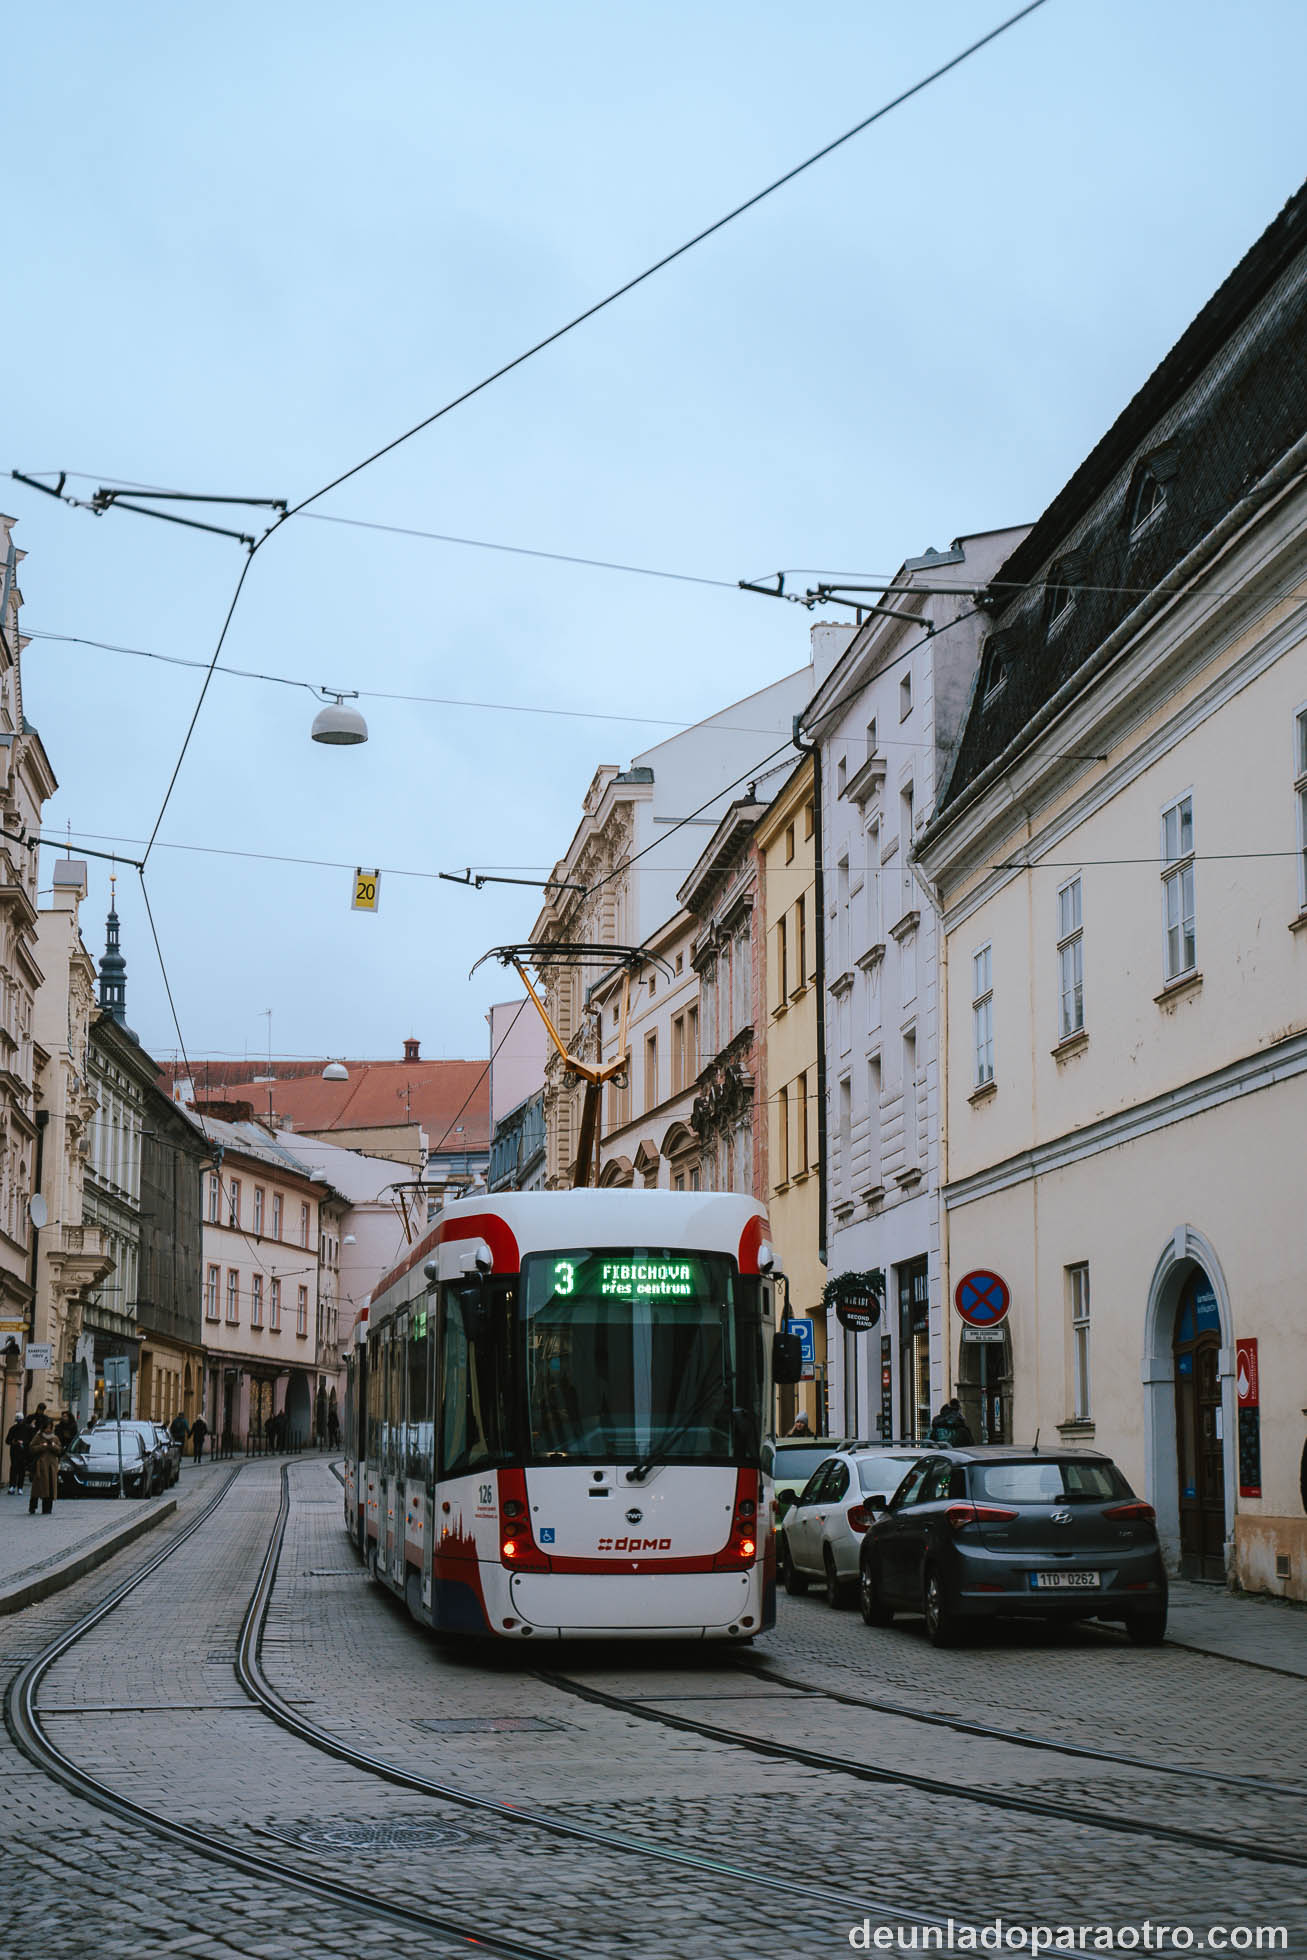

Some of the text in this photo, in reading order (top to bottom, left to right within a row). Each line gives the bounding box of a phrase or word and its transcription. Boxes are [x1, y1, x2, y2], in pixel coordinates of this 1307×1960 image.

[356, 882, 376, 900] 20
[554, 1262, 574, 1295] 3
[636, 1281, 691, 1294] centrum
[847, 1313, 870, 1322] SECOND
[479, 1484, 493, 1504] 126
[1067, 1573, 1095, 1586] 0262
